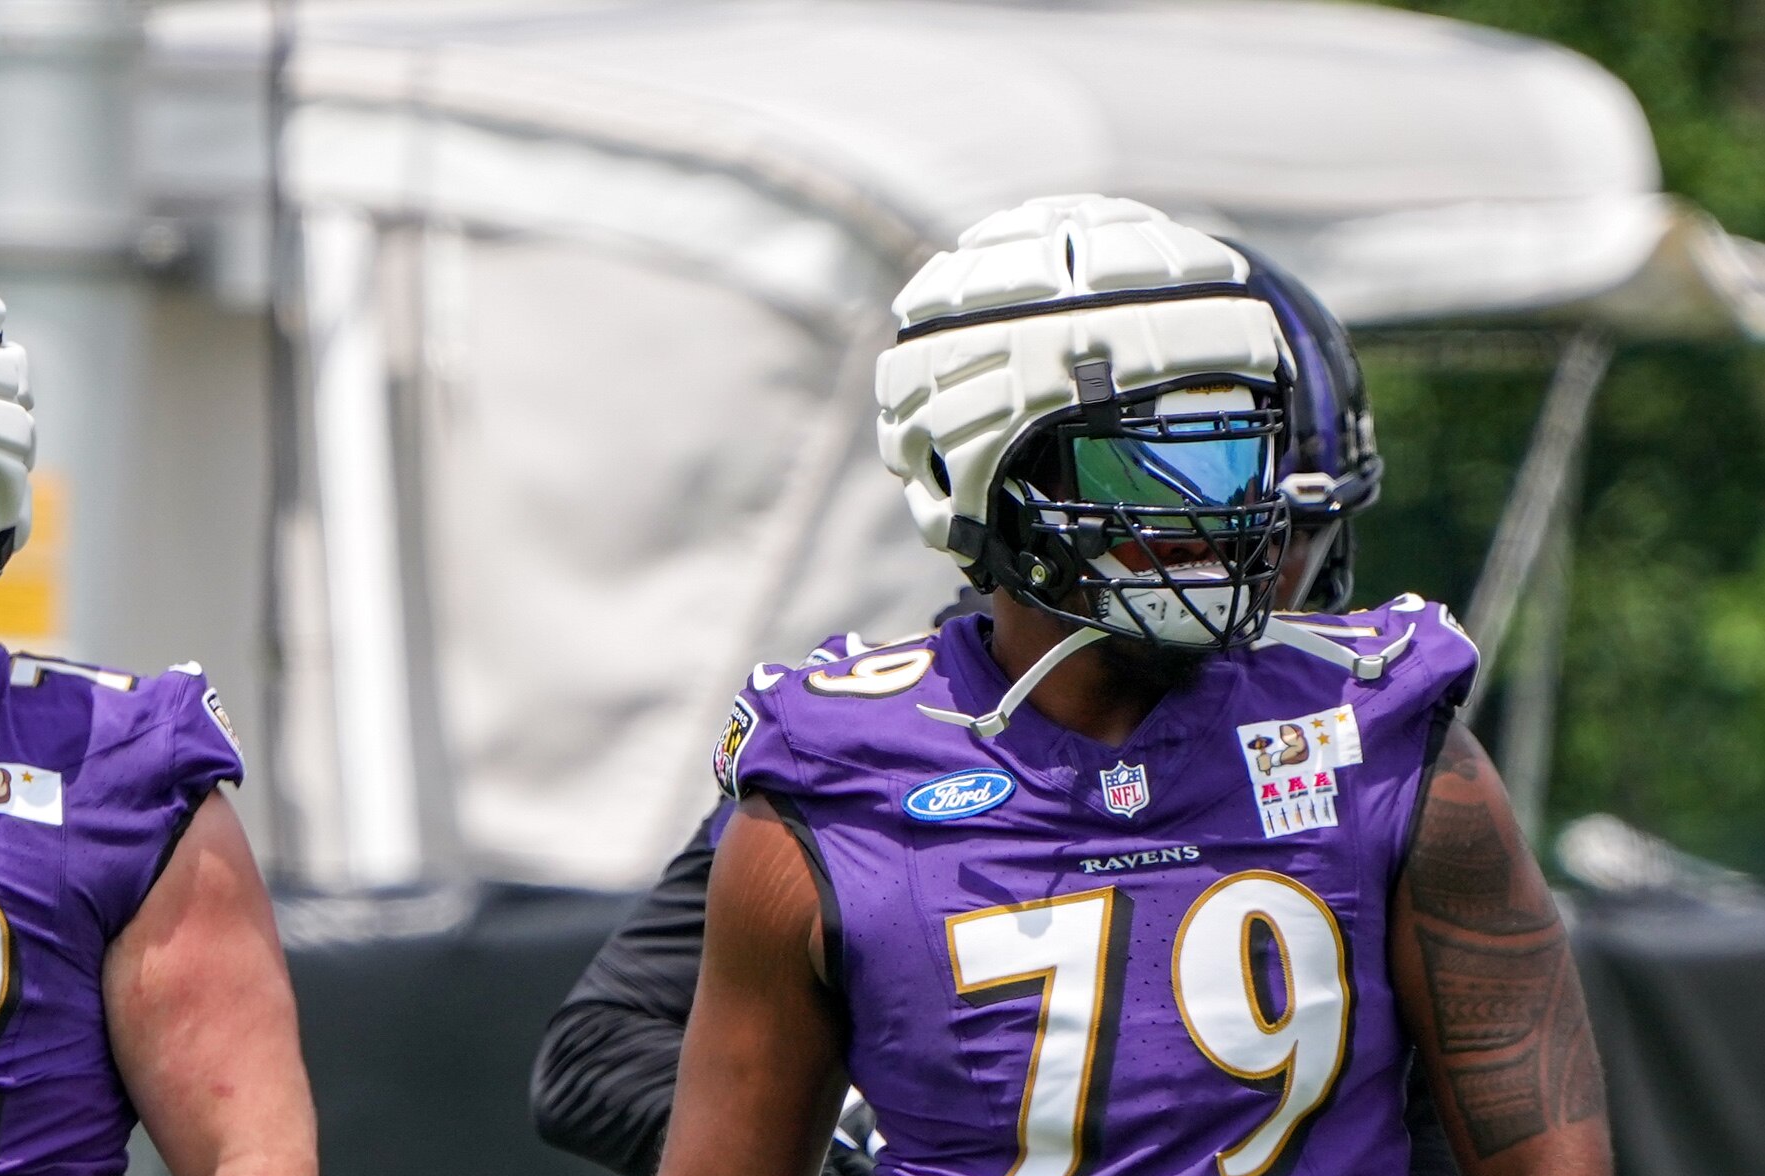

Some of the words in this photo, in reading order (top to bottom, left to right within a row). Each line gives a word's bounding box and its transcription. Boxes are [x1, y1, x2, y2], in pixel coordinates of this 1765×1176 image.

[928, 778, 992, 812] Ford
[1111, 783, 1143, 810] NFL
[1078, 843, 1201, 874] RAVENS
